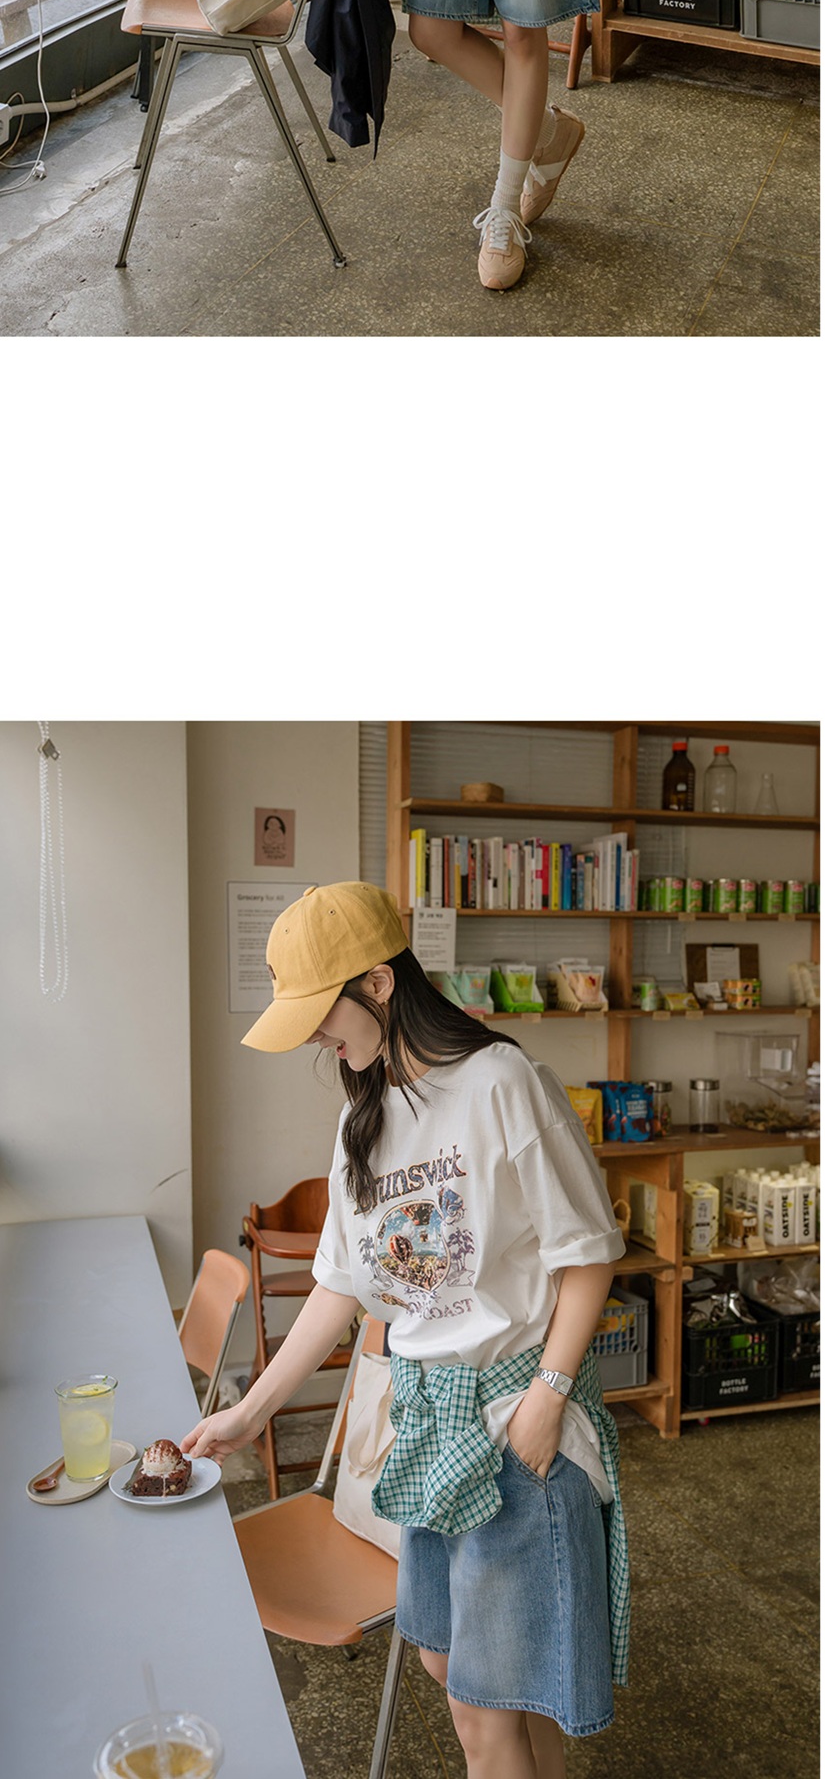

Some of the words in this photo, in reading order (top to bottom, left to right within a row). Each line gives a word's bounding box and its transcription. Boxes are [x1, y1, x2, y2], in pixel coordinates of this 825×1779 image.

[659, 0, 696, 10] FACTORY
[782, 1195, 790, 1239] OATSIDE
[721, 1378, 746, 1387] BOTTLE
[719, 1385, 749, 1395] FACTORY
